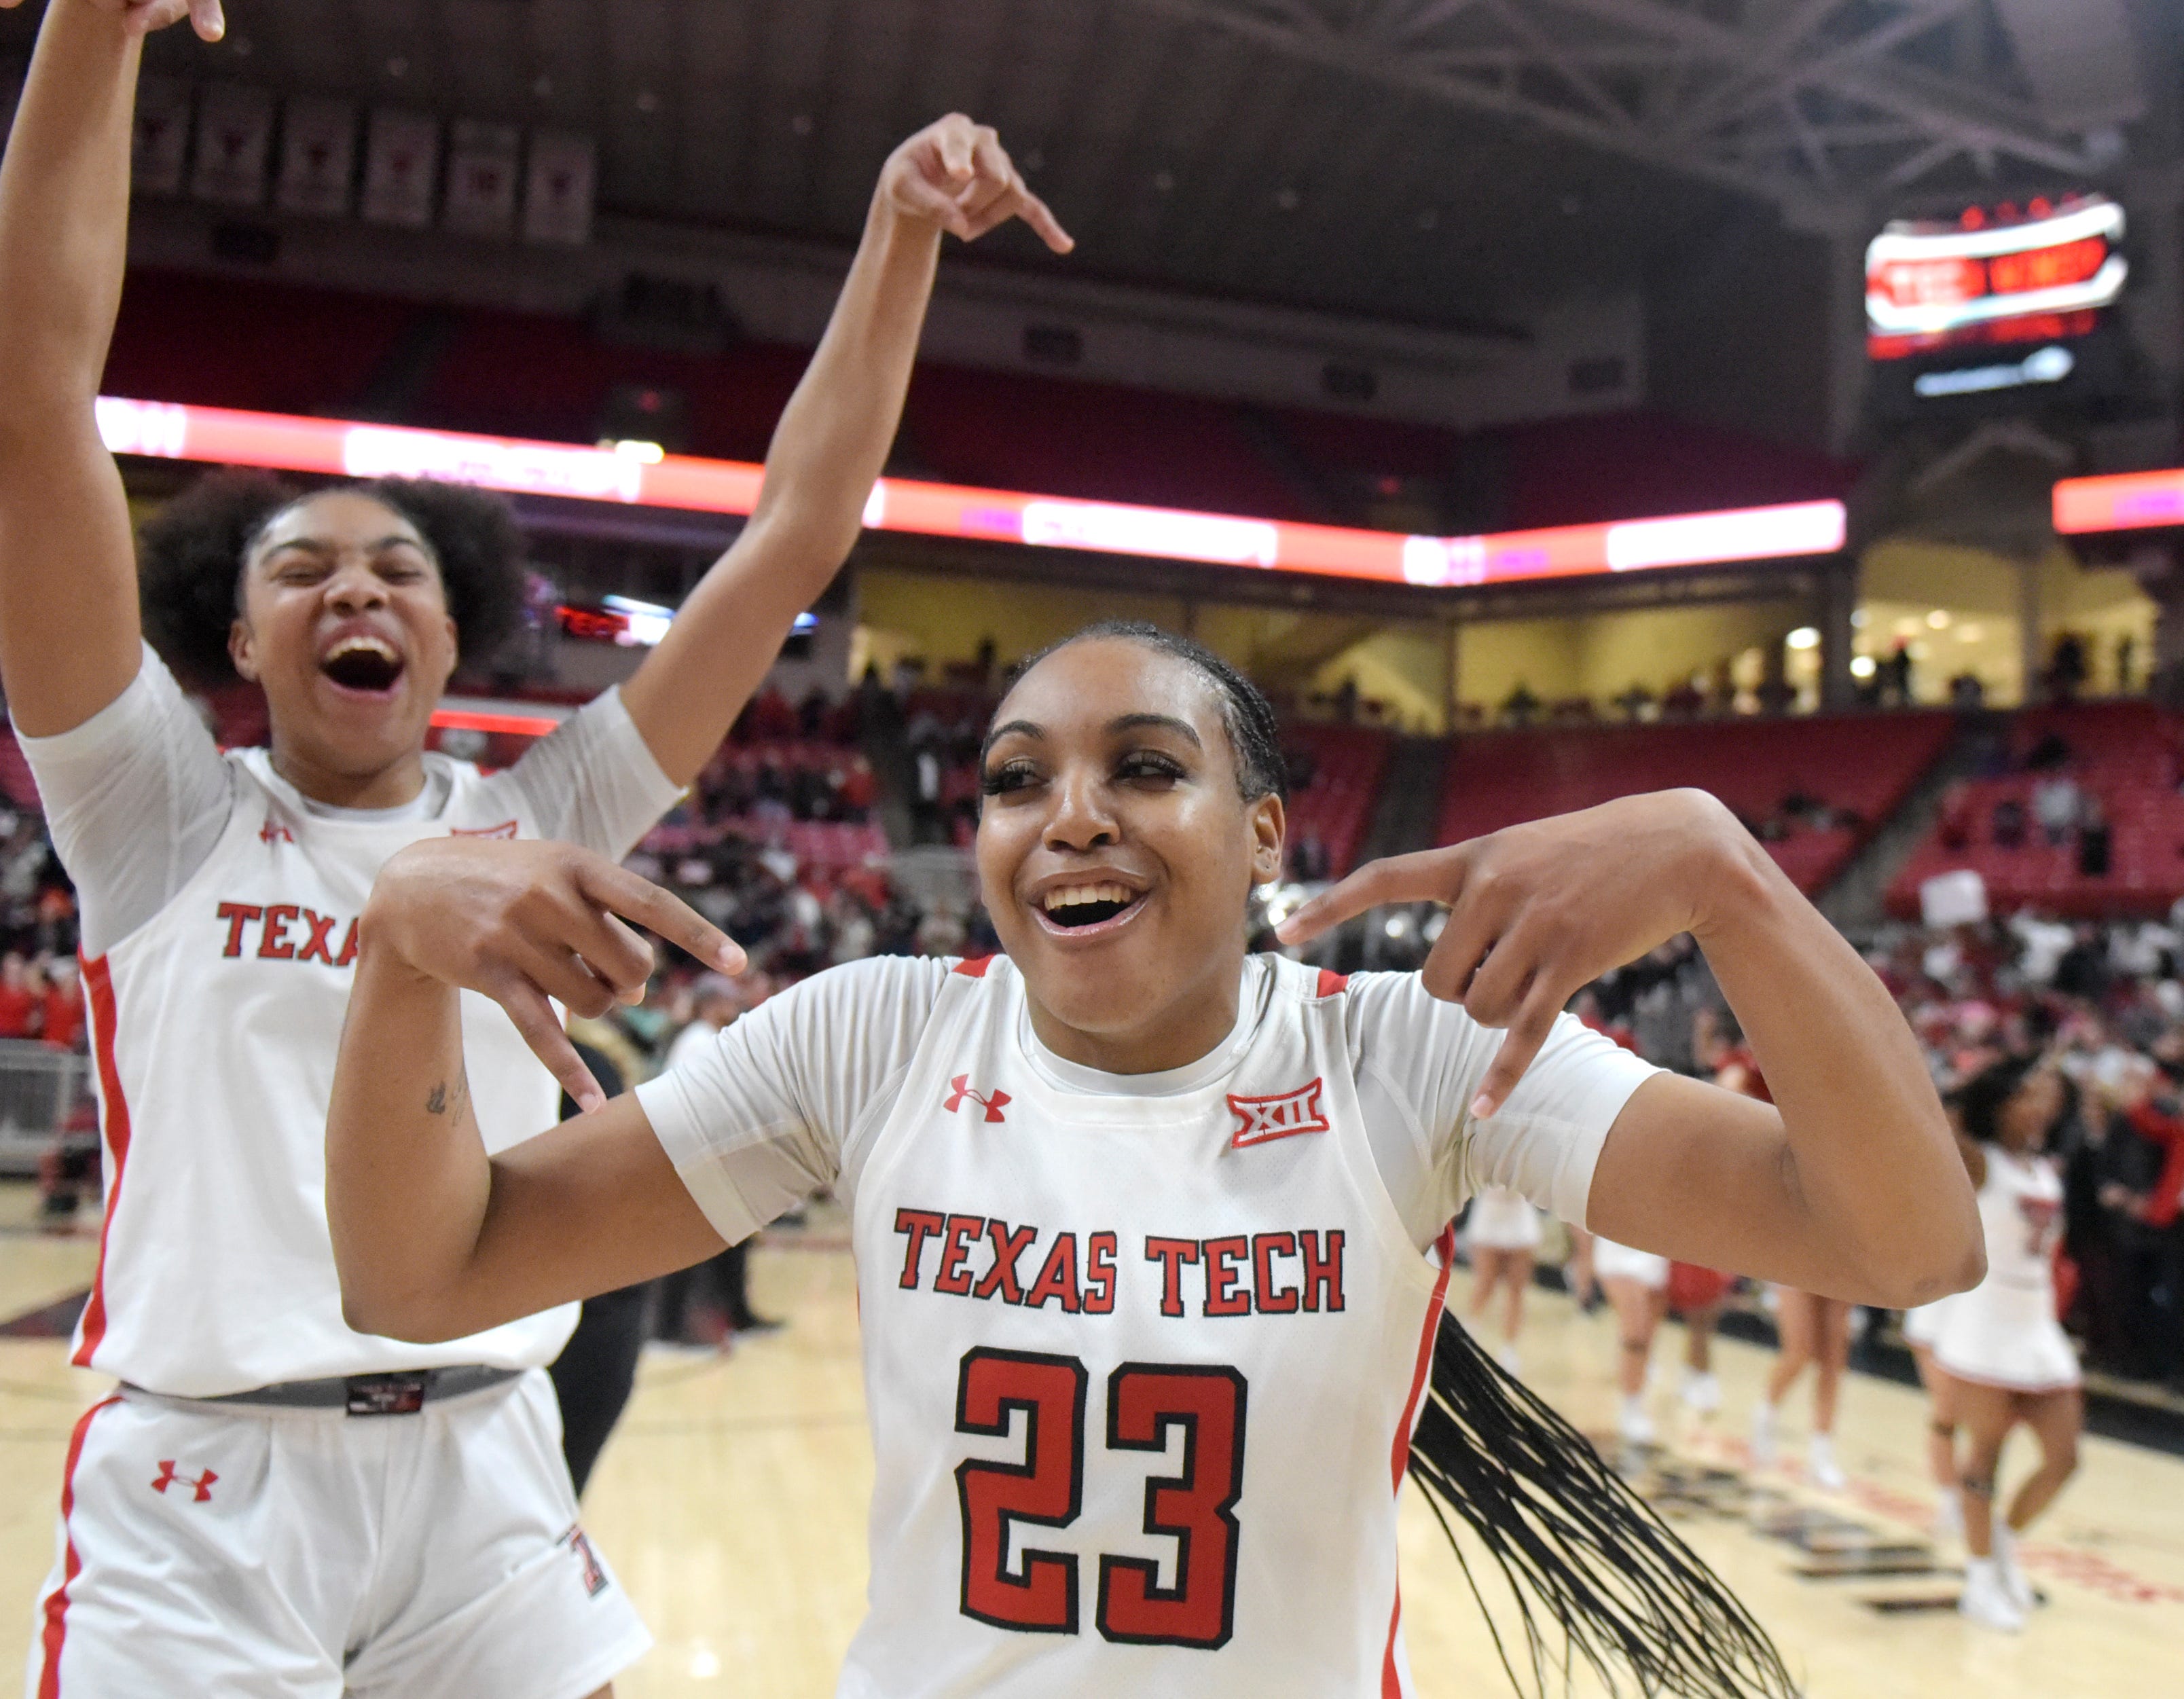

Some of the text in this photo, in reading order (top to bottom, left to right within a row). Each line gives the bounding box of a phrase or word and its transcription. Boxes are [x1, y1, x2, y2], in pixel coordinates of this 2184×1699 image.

[1231, 1084, 1325, 1144] XII
[894, 1208, 1345, 1317] TEXAS TECH
[954, 1345, 1248, 1651] 23
